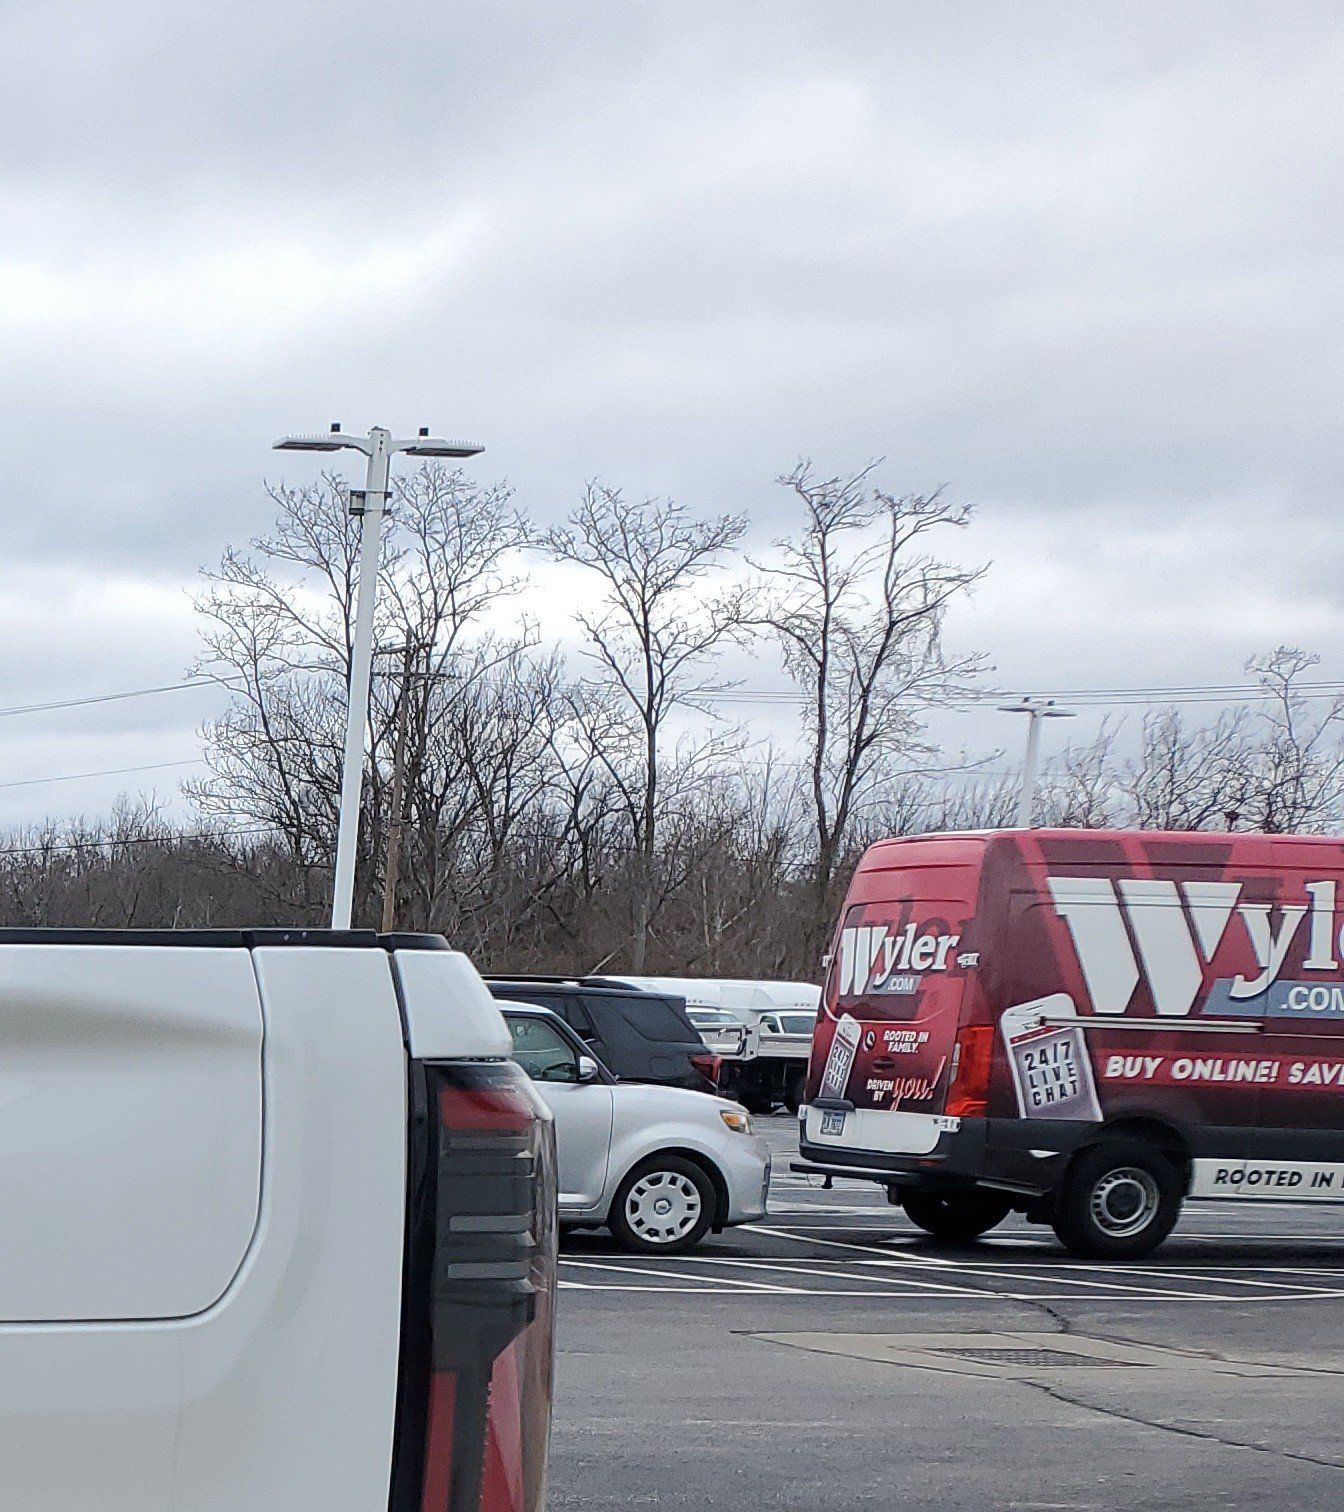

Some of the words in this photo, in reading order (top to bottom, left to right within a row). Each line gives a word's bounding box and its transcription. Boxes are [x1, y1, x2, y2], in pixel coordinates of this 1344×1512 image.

[839, 923, 959, 996] Wyler
[1046, 876, 1344, 1016] Wyl
[888, 977, 915, 991] .COM
[883, 1030, 916, 1041] ROOTED
[1023, 1041, 1071, 1071] 24/7
[1105, 1055, 1163, 1078] BUY
[1171, 1058, 1279, 1083] ONLINE!
[866, 1079, 894, 1091] DRIVEN
[1030, 1061, 1075, 1089] LIVE
[1032, 1079, 1079, 1106] CHAT
[1214, 1168, 1303, 1187] ROOTED
[1310, 1171, 1335, 1188] IN
